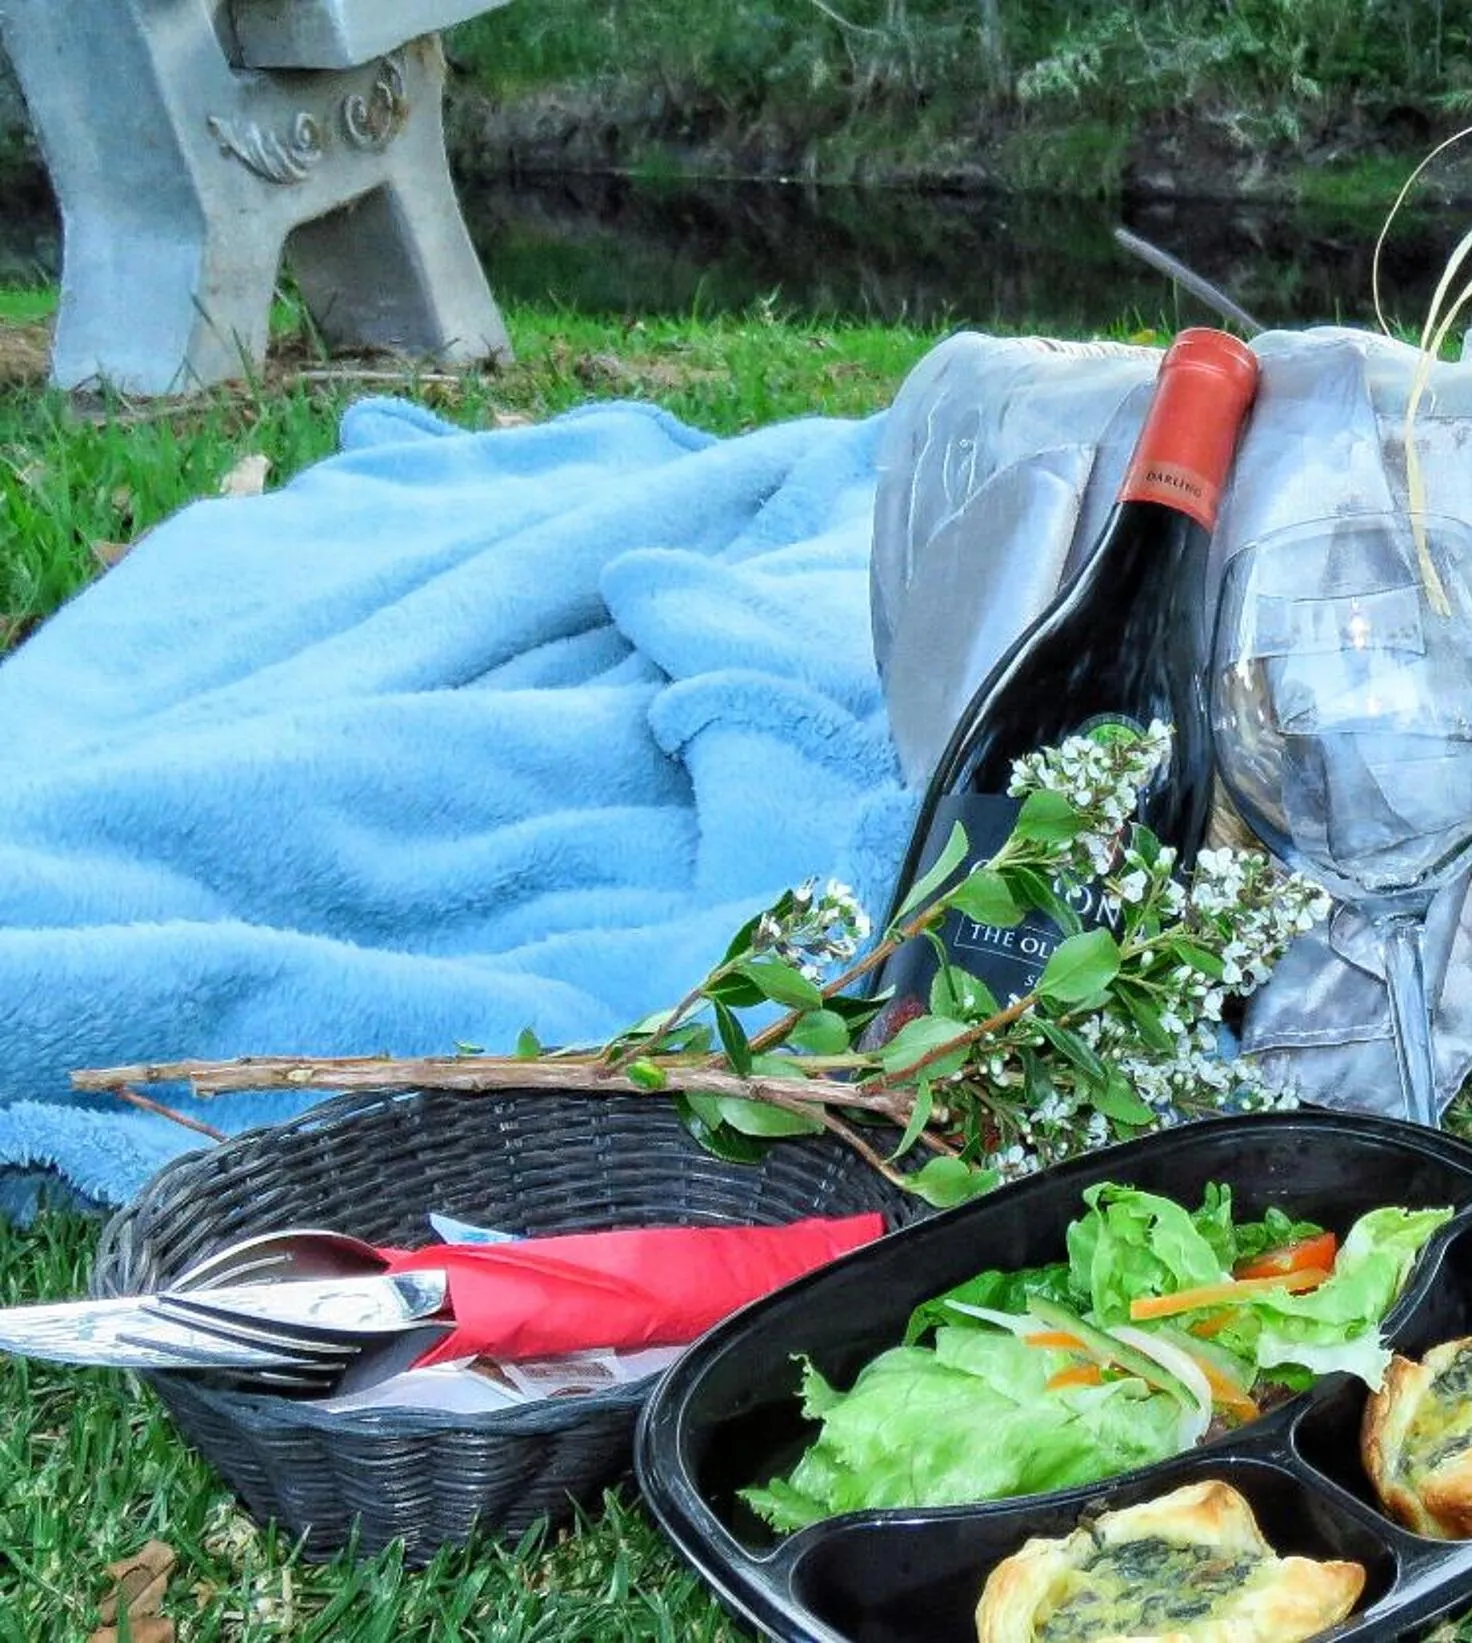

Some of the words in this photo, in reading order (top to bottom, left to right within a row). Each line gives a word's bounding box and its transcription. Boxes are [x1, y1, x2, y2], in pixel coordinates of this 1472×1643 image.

[1145, 470, 1202, 498] DARLING
[970, 923, 1016, 949] THE
[1020, 936, 1058, 960] OL
